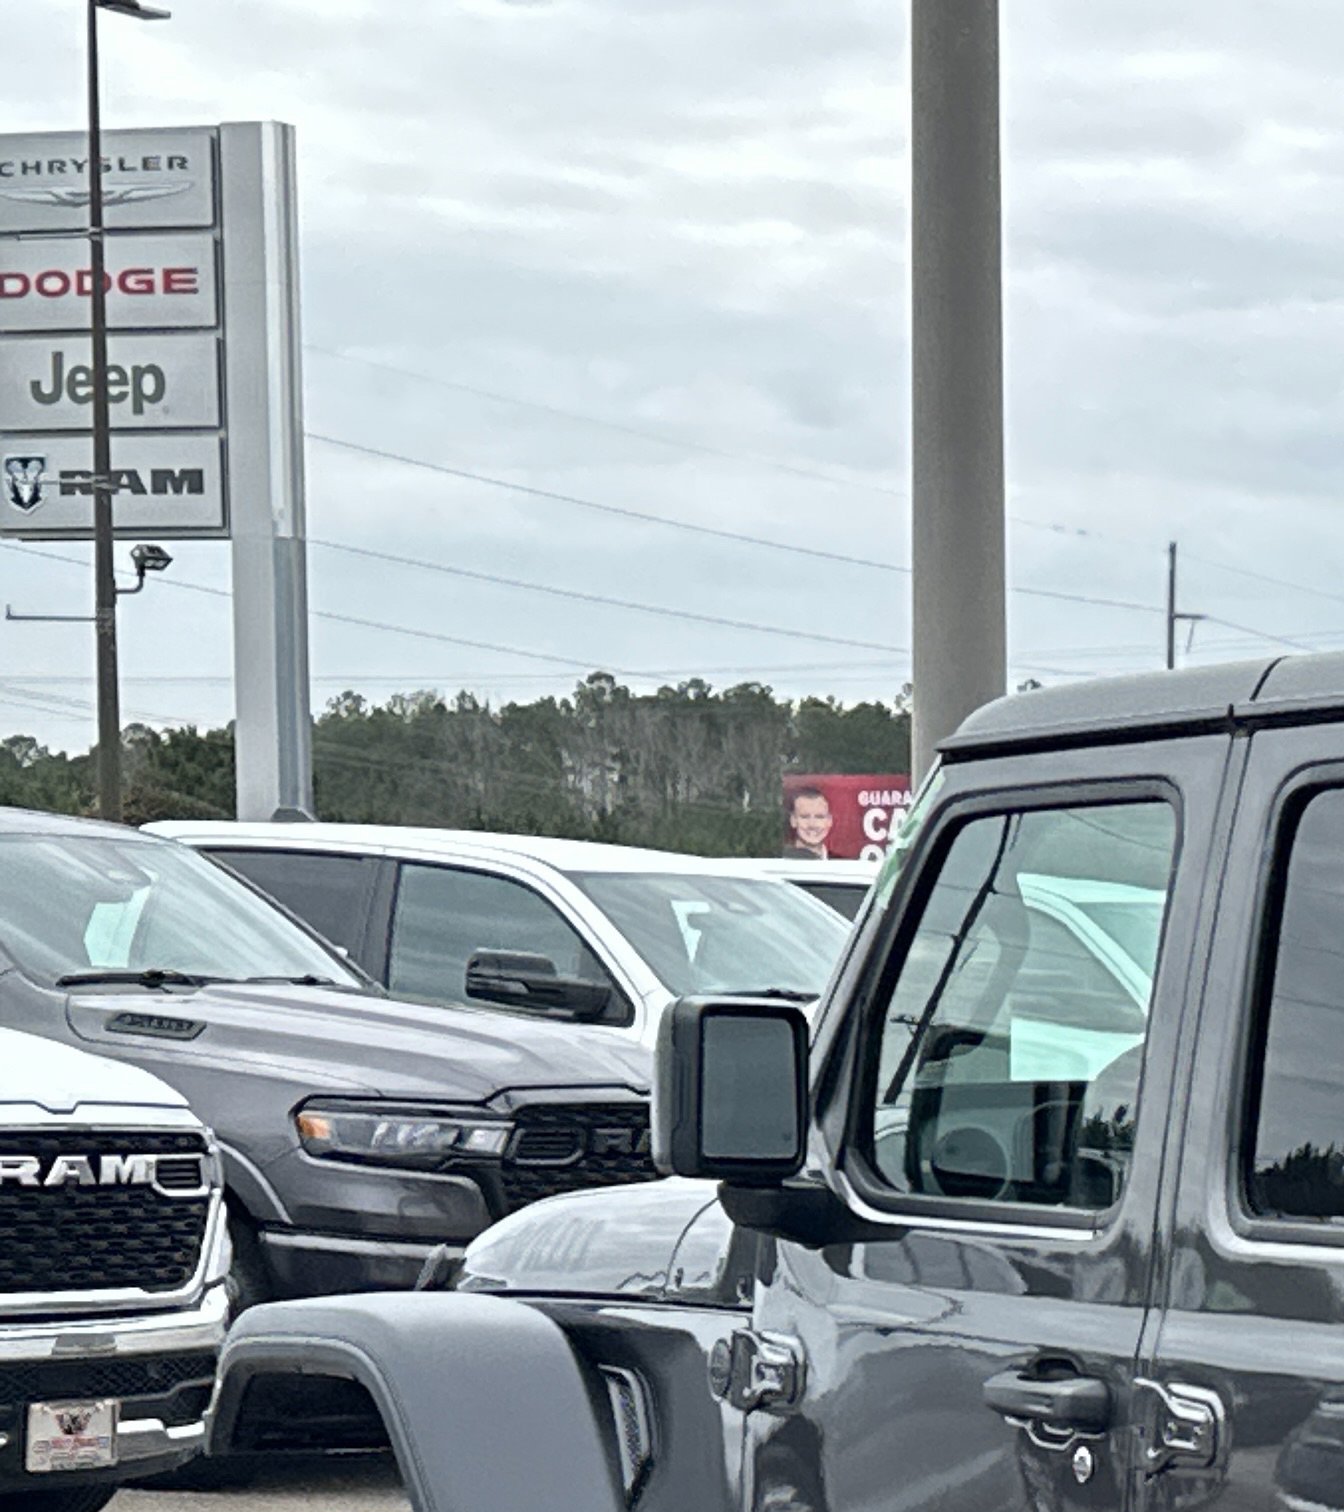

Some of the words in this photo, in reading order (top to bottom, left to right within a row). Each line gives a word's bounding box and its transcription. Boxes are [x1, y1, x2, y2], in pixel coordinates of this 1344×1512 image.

[0, 155, 189, 177] CHRYSLER
[0, 267, 199, 299] DODGE
[30, 351, 166, 415] Jeep
[59, 468, 204, 497] RAM
[0, 1154, 150, 1186] RAM
